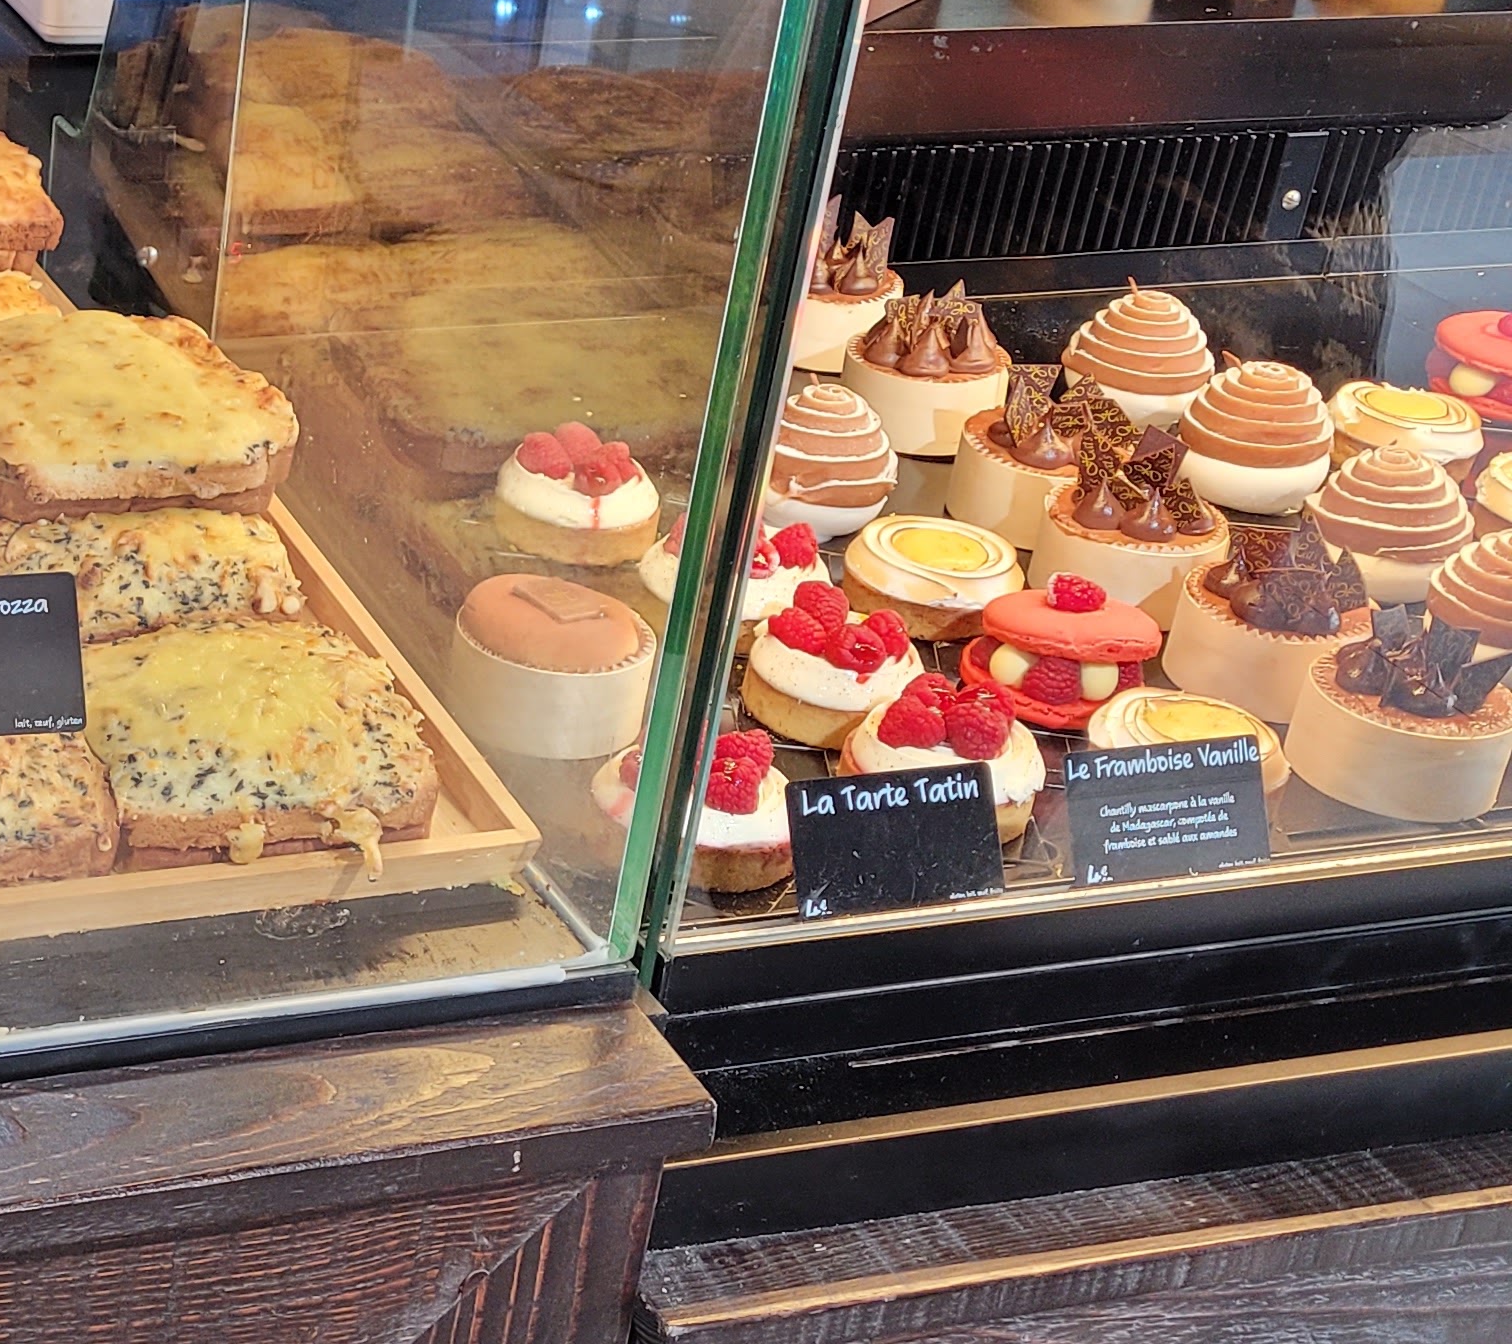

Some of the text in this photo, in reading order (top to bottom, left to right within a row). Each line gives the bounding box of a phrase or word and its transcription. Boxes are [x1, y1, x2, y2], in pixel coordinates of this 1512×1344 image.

[56, 715, 83, 730] gluten
[1067, 736, 1260, 781] Le Framboise Vanille
[801, 772, 979, 817] La Tarte Tatin
[1099, 791, 1236, 818] Chantilly mascarpone à la vanille
[1110, 820, 1121, 833] de
[1121, 818, 1177, 834] Madagascar,
[1217, 809, 1229, 822] de
[1102, 825, 1238, 855] framboise et sablé aux amandes
